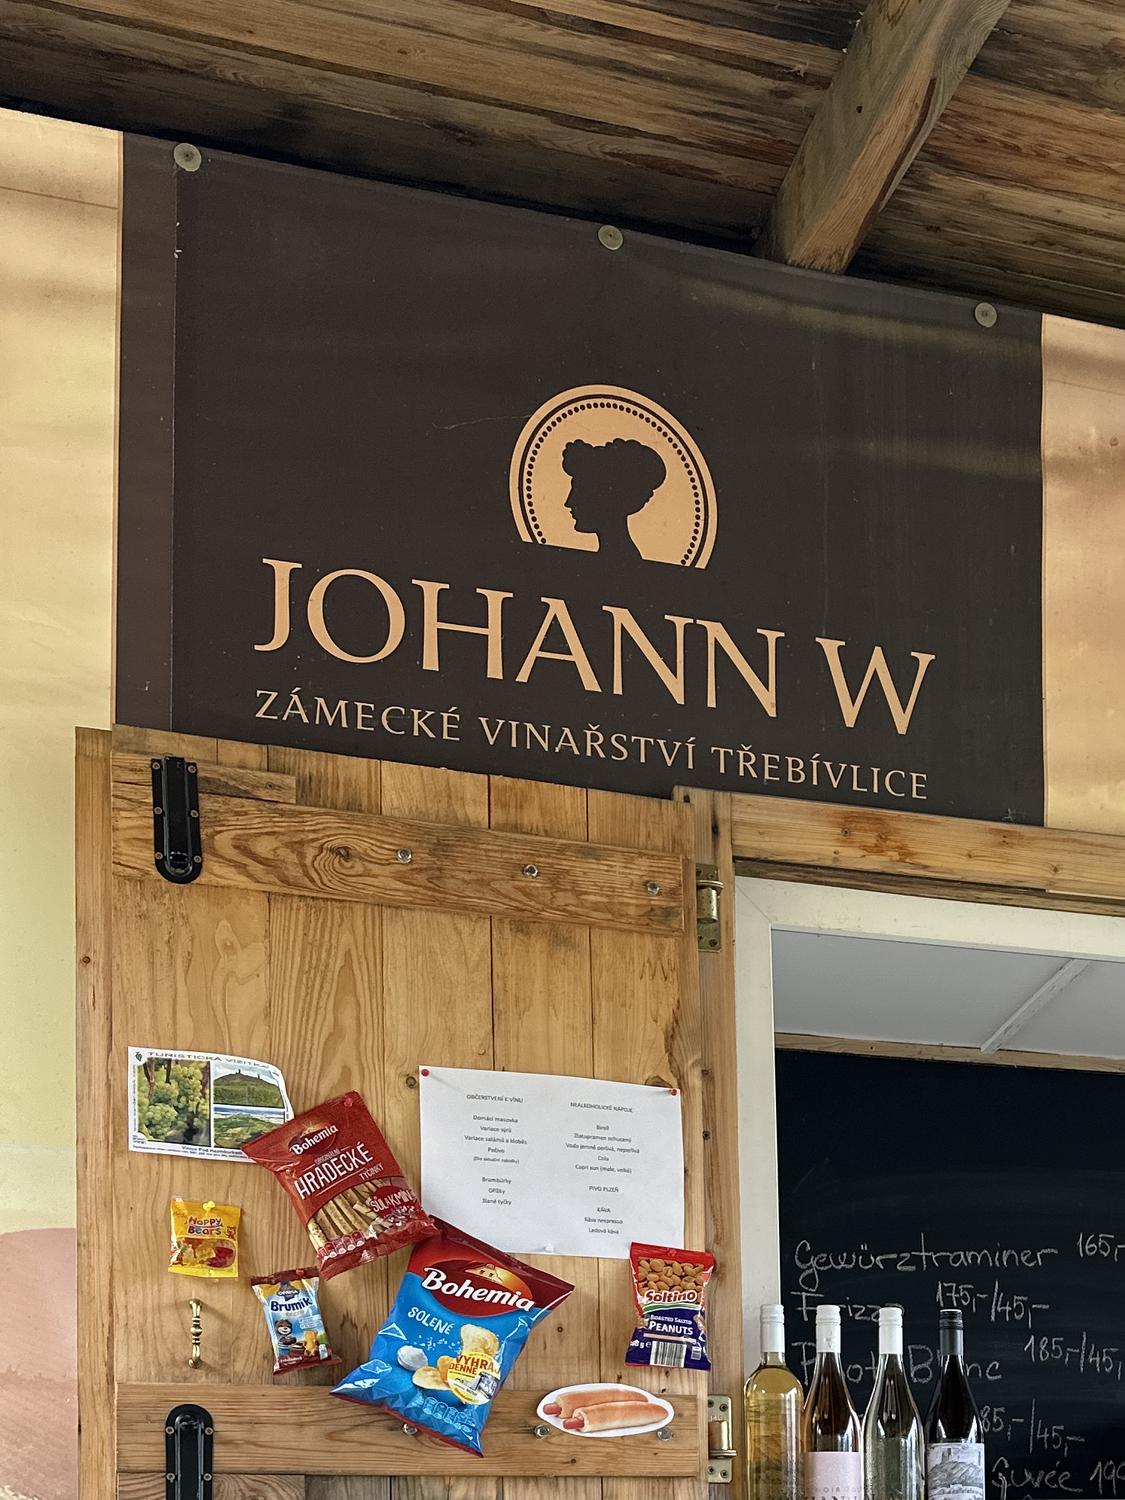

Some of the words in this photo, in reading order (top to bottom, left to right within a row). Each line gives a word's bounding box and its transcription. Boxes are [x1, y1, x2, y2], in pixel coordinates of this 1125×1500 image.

[254, 557, 785, 719] JOHANN
[815, 636, 936, 737] W
[254, 684, 461, 743] ZÁMECKÉ
[478, 714, 700, 771] VINAŘSTVÍ
[711, 744, 930, 801] TŘEBÍVLICE
[289, 1124, 340, 1156] Bohemia
[294, 1141, 374, 1200] HRADECKÉ
[187, 1226, 223, 1236] Bears
[794, 1232, 1058, 1292] Gewürztraminer
[421, 1267, 537, 1312] Bohemia
[407, 1306, 455, 1335] SOLENÉ
[649, 1321, 694, 1336] PEANUTS
[791, 1341, 878, 1386] Pot
[907, 1344, 1002, 1384] Blnc
